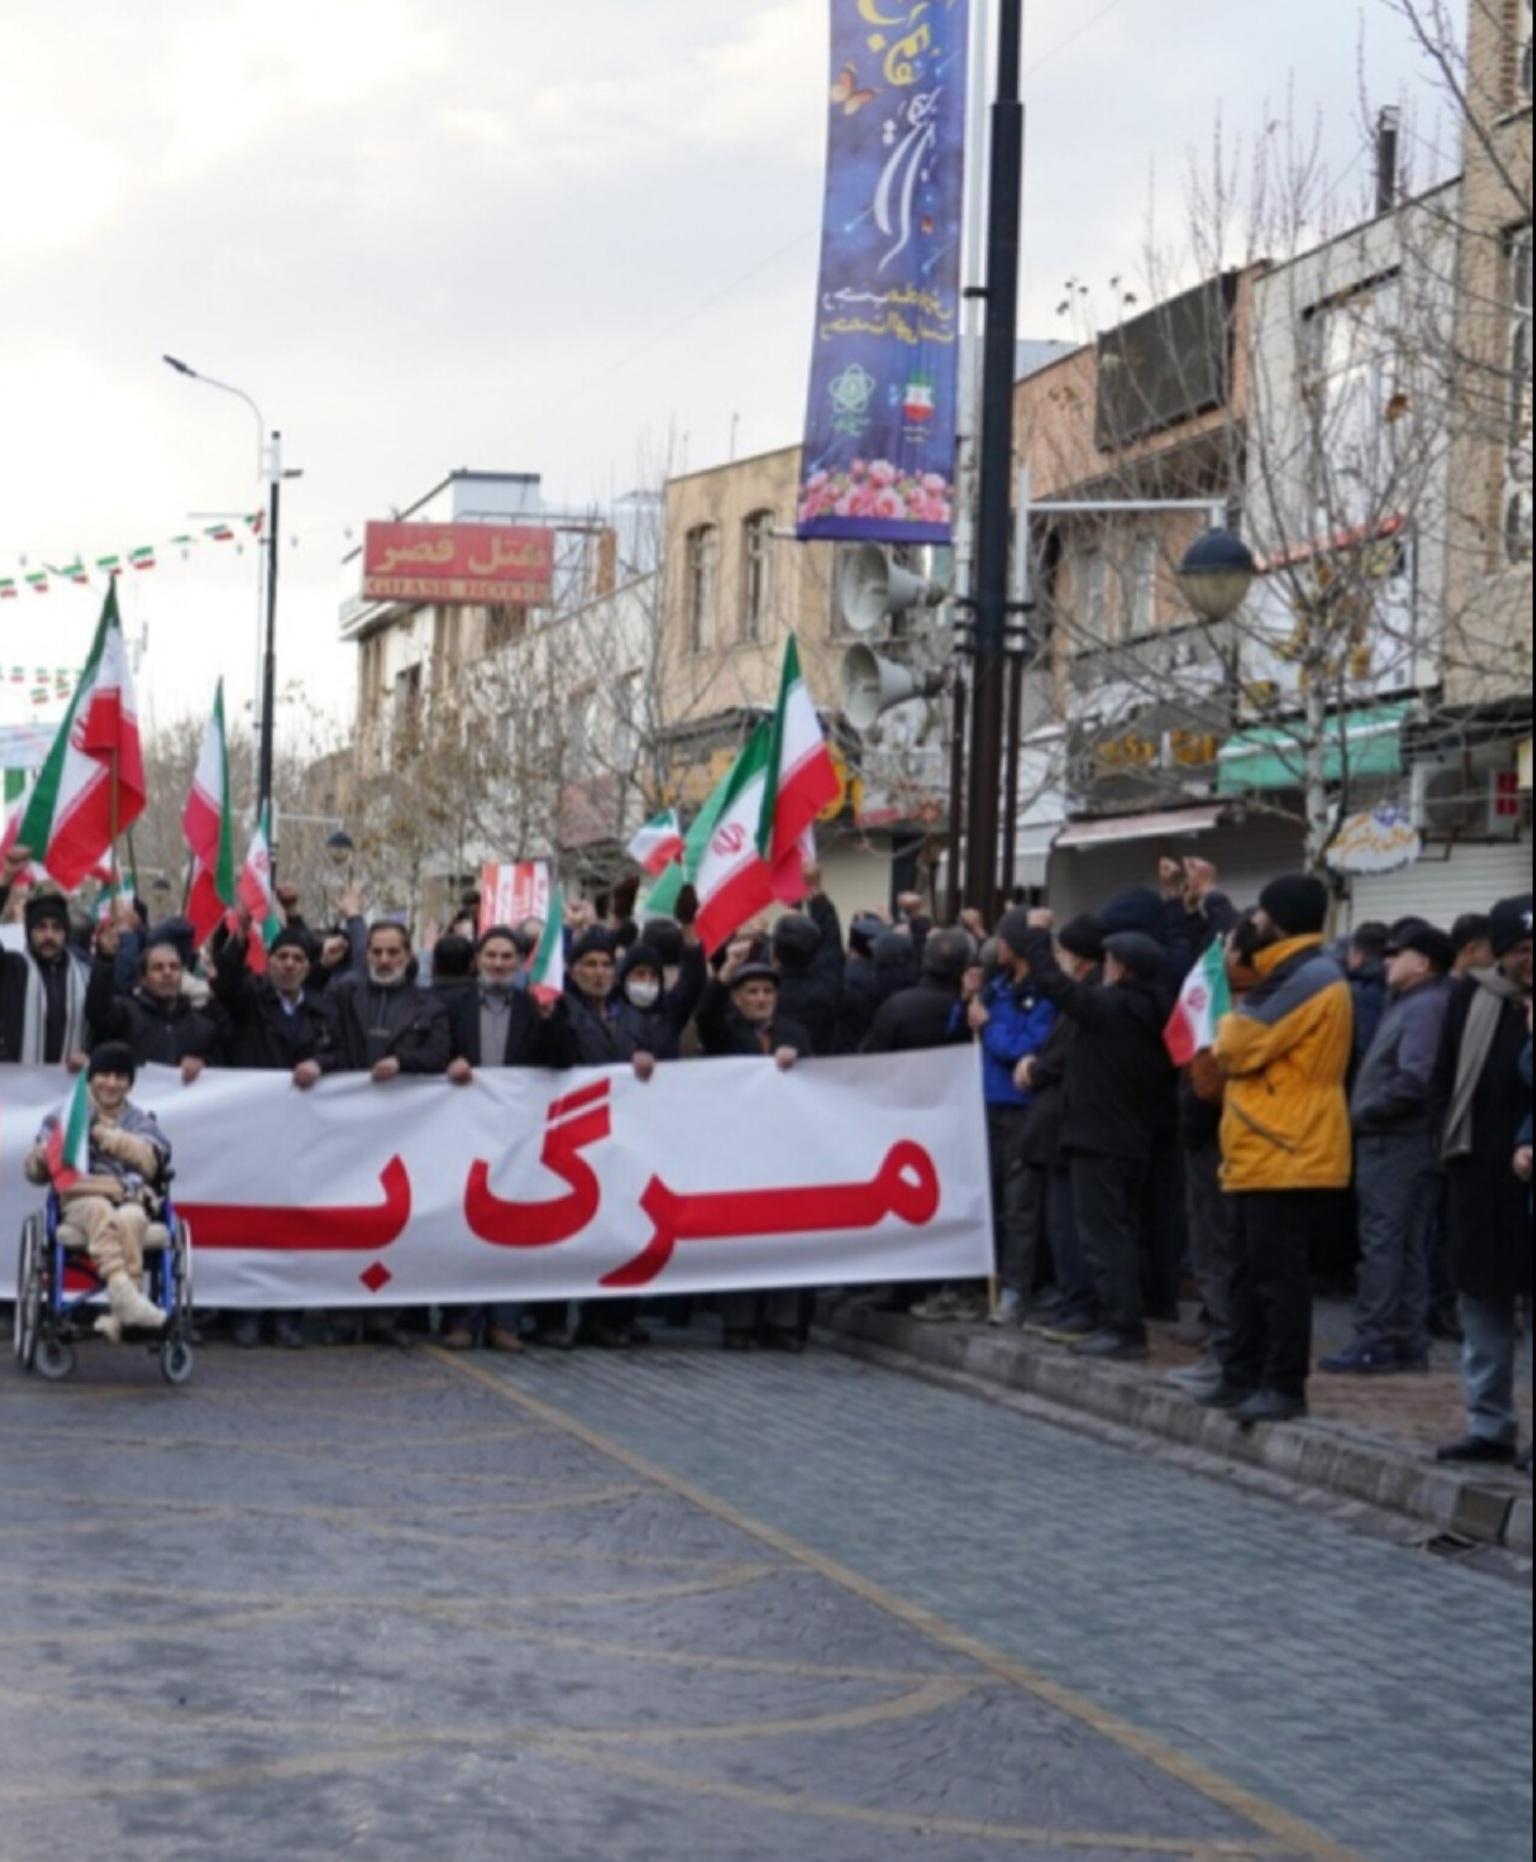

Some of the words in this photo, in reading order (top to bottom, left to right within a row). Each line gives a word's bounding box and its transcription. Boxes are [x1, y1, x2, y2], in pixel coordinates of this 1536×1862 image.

[373, 532, 455, 573] قصر
[42, 1155, 411, 1293] ب
[465, 1077, 942, 1288] مرگ
